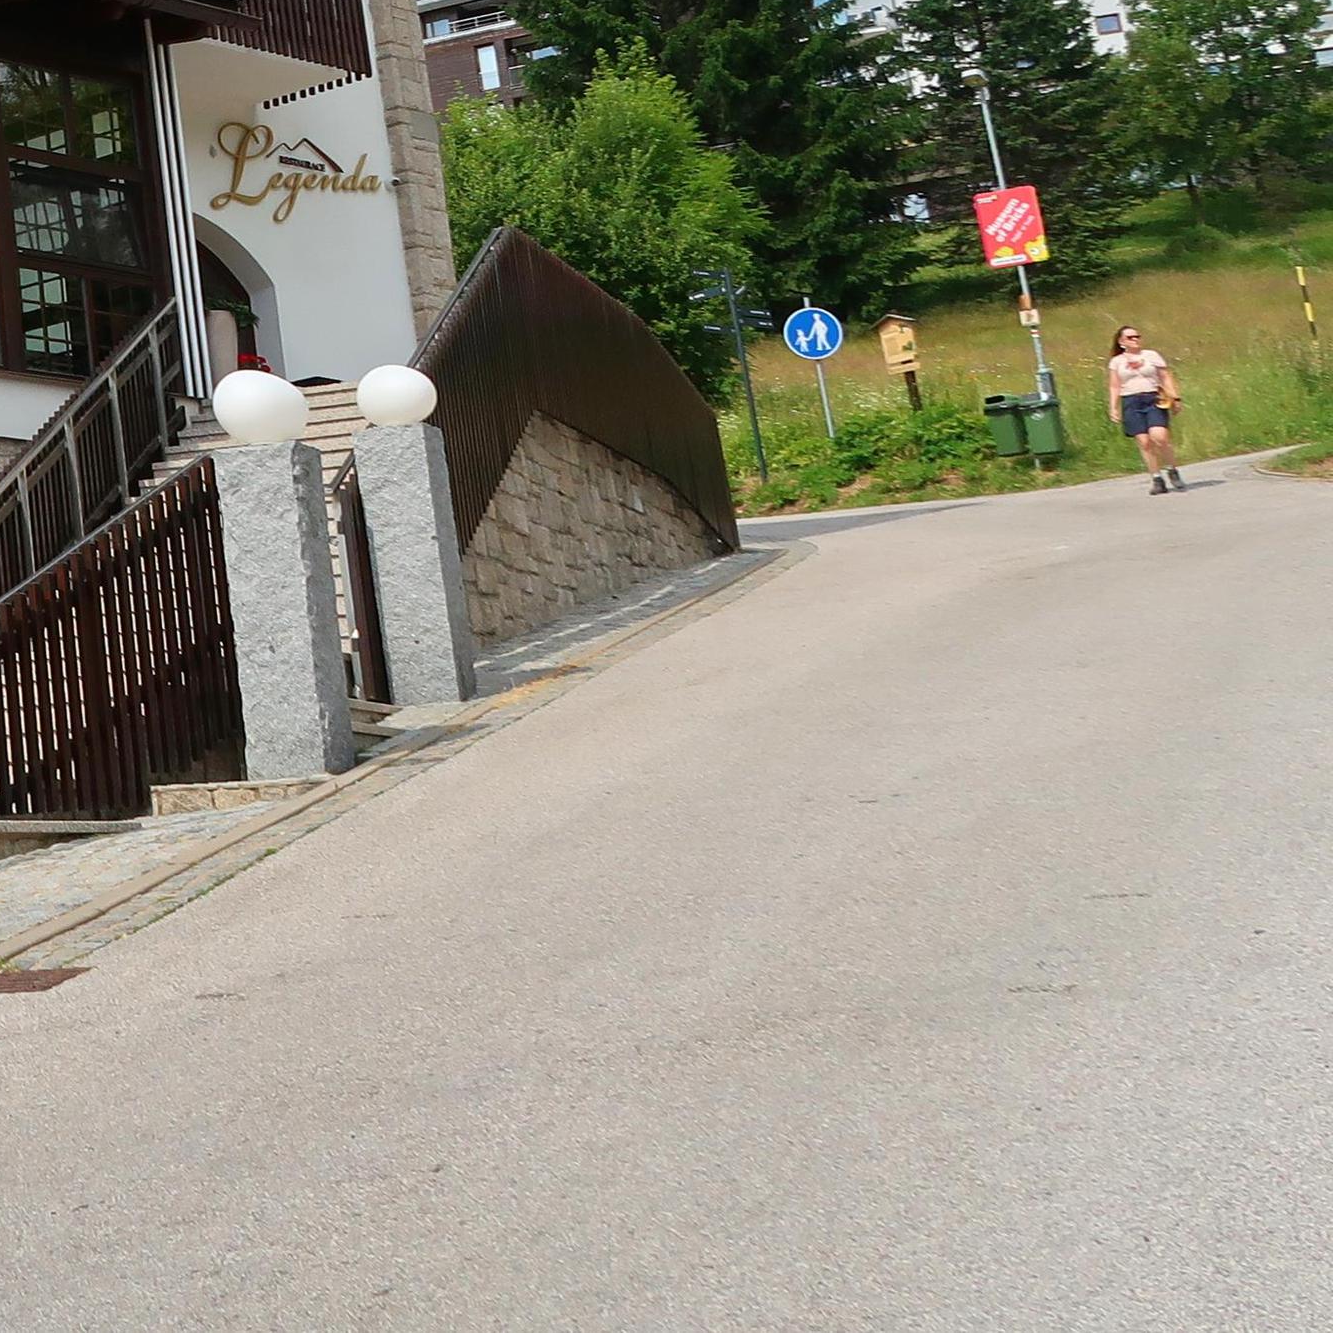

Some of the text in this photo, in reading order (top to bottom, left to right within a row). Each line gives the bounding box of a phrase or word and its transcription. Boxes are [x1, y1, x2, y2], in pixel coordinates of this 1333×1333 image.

[209, 121, 383, 225] Legenda
[984, 198, 1020, 235] Museum
[995, 229, 1008, 242] of
